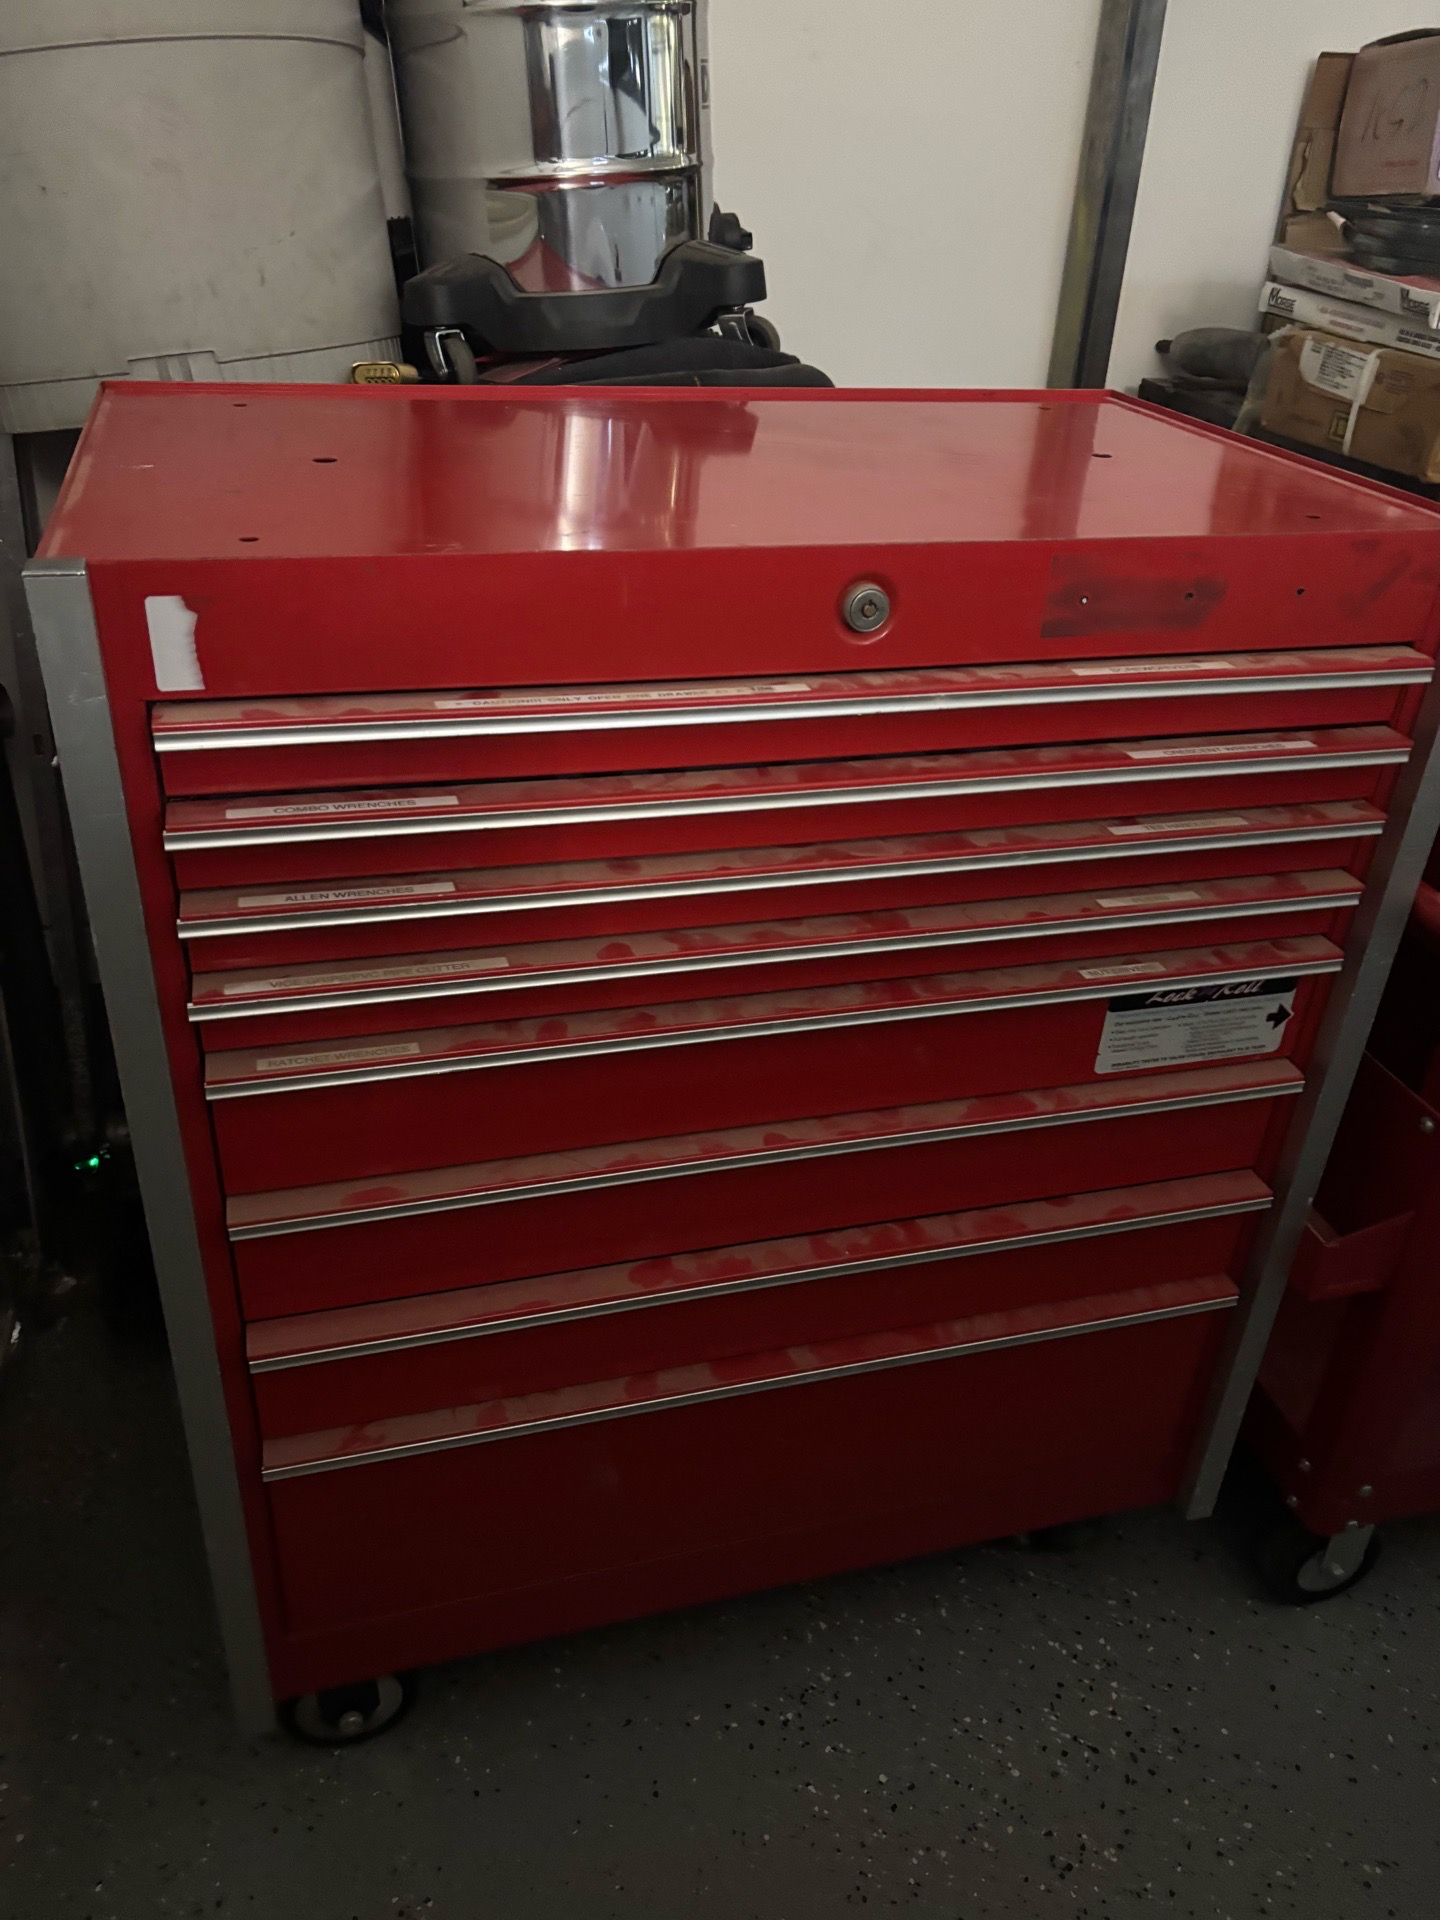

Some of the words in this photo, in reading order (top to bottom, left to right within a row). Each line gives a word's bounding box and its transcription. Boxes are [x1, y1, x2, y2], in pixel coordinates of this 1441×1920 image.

[272, 804, 330, 814] COMBO
[333, 799, 417, 811] WRENCHES
[284, 893, 330, 903] ALLEN
[333, 886, 416, 899] WRENCHES
[415, 962, 470, 975] CUTTER
[1144, 987, 1195, 1005] Lock
[267, 1054, 332, 1068] RATCHET
[334, 1044, 412, 1060] WRENCHES
